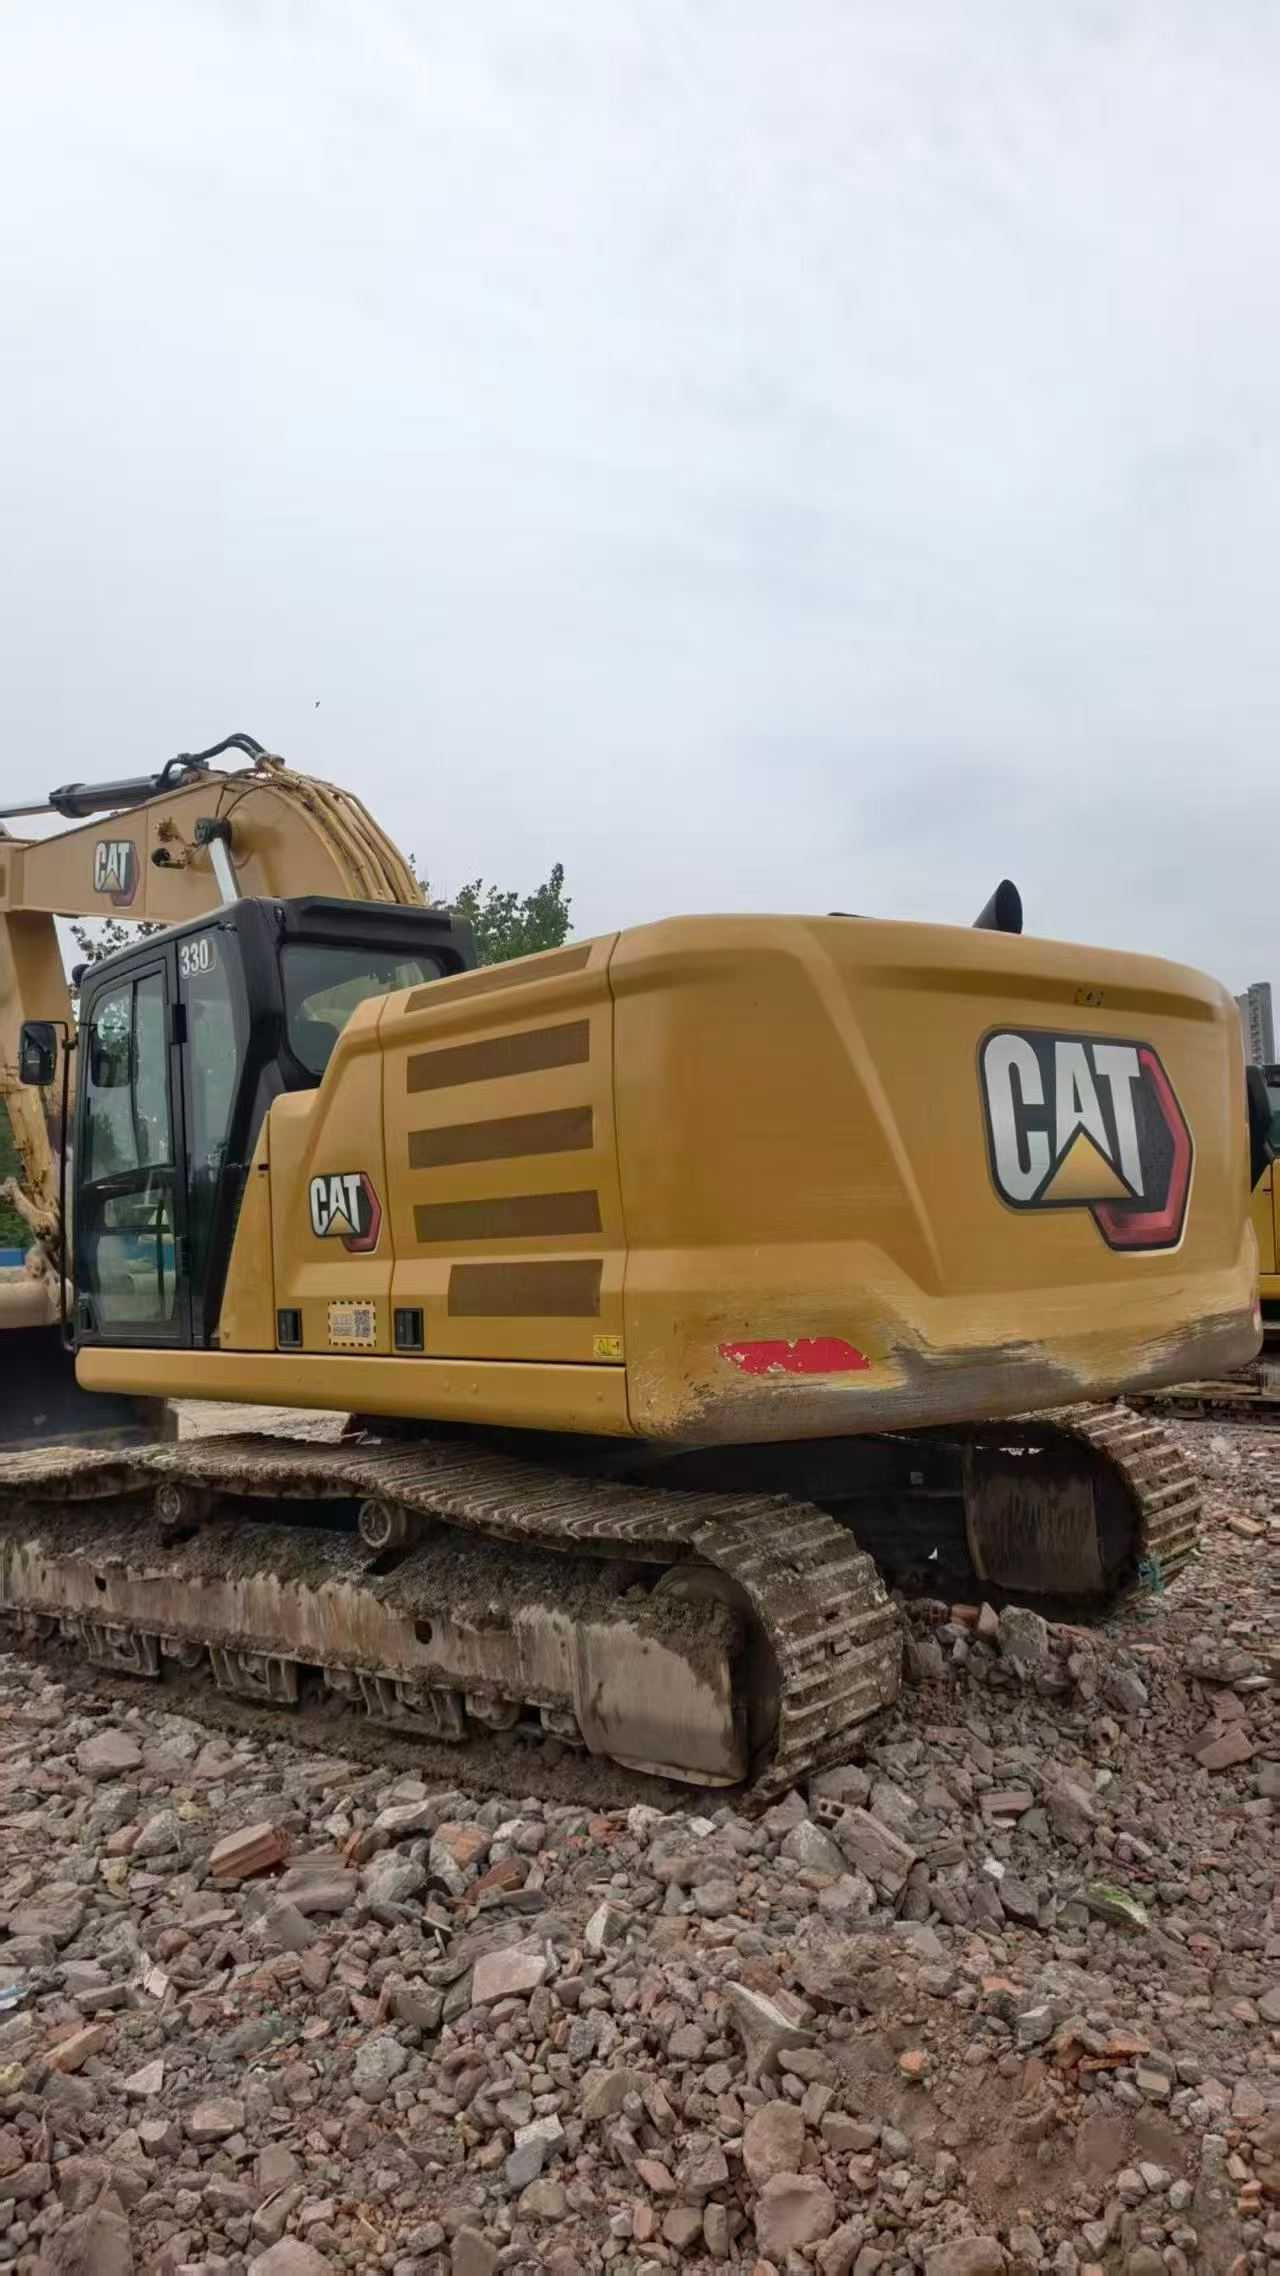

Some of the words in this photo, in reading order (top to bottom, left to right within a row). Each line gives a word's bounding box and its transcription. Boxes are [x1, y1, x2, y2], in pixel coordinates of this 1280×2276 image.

[95, 842, 130, 891] CAT
[181, 939, 209, 976] 330
[984, 1034, 1145, 1201] CAT
[311, 1174, 361, 1235] CAT
